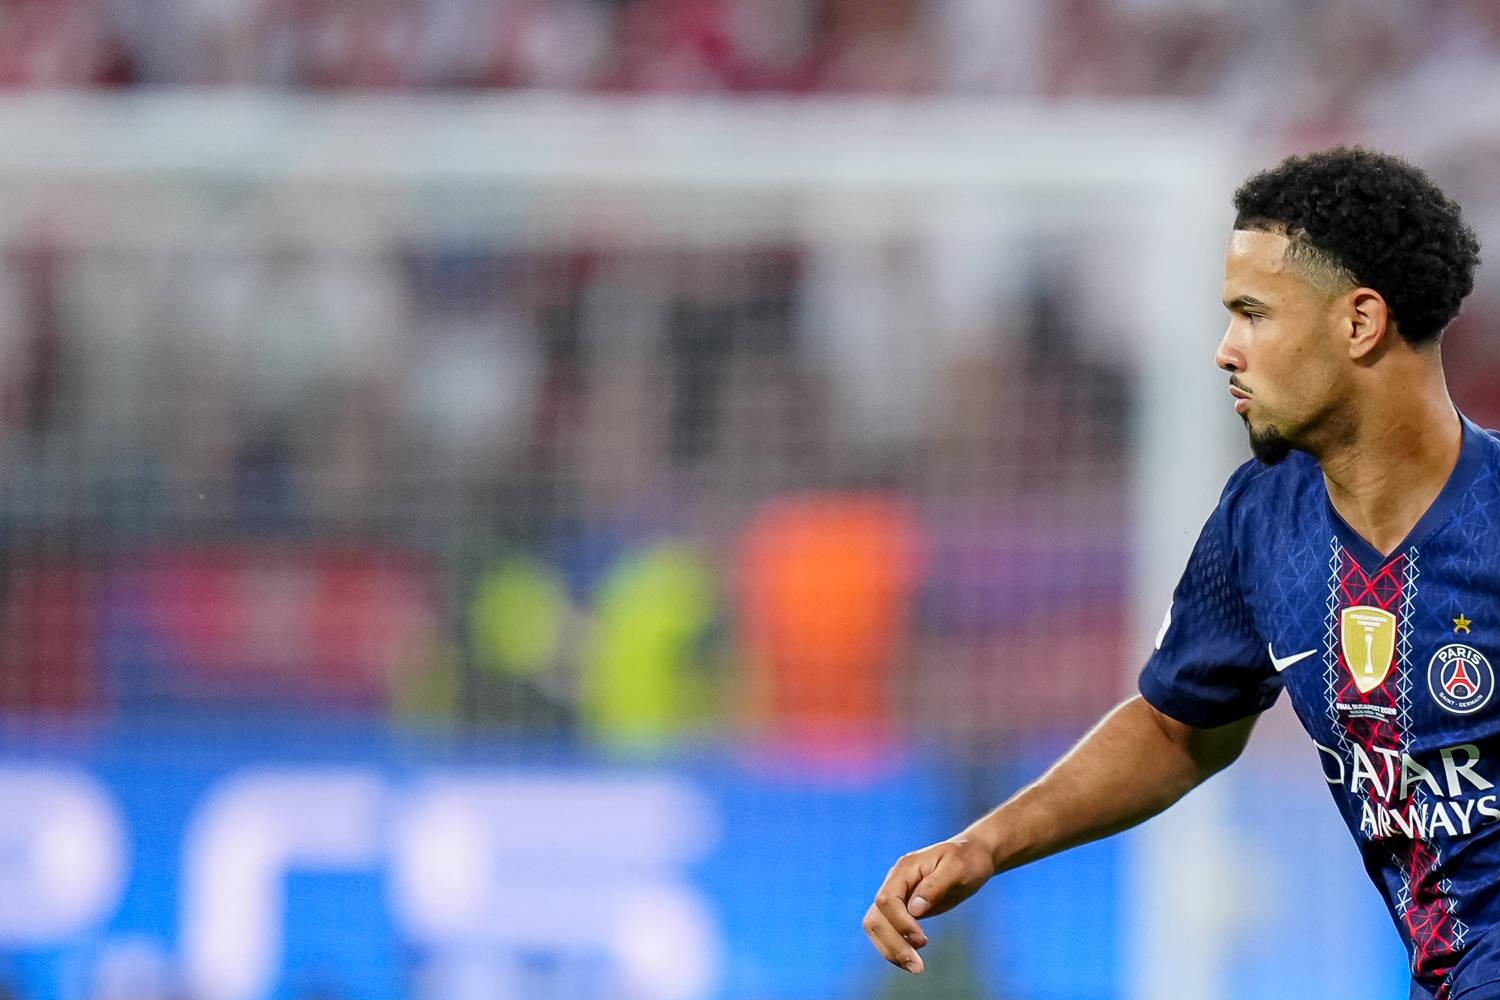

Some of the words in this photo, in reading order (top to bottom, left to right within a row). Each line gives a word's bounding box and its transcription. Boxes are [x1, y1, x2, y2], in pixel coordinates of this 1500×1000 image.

[1438, 647, 1482, 665] PARIS
[1439, 691, 1455, 706] SAINT
[1458, 694, 1483, 708] GERMAIN
